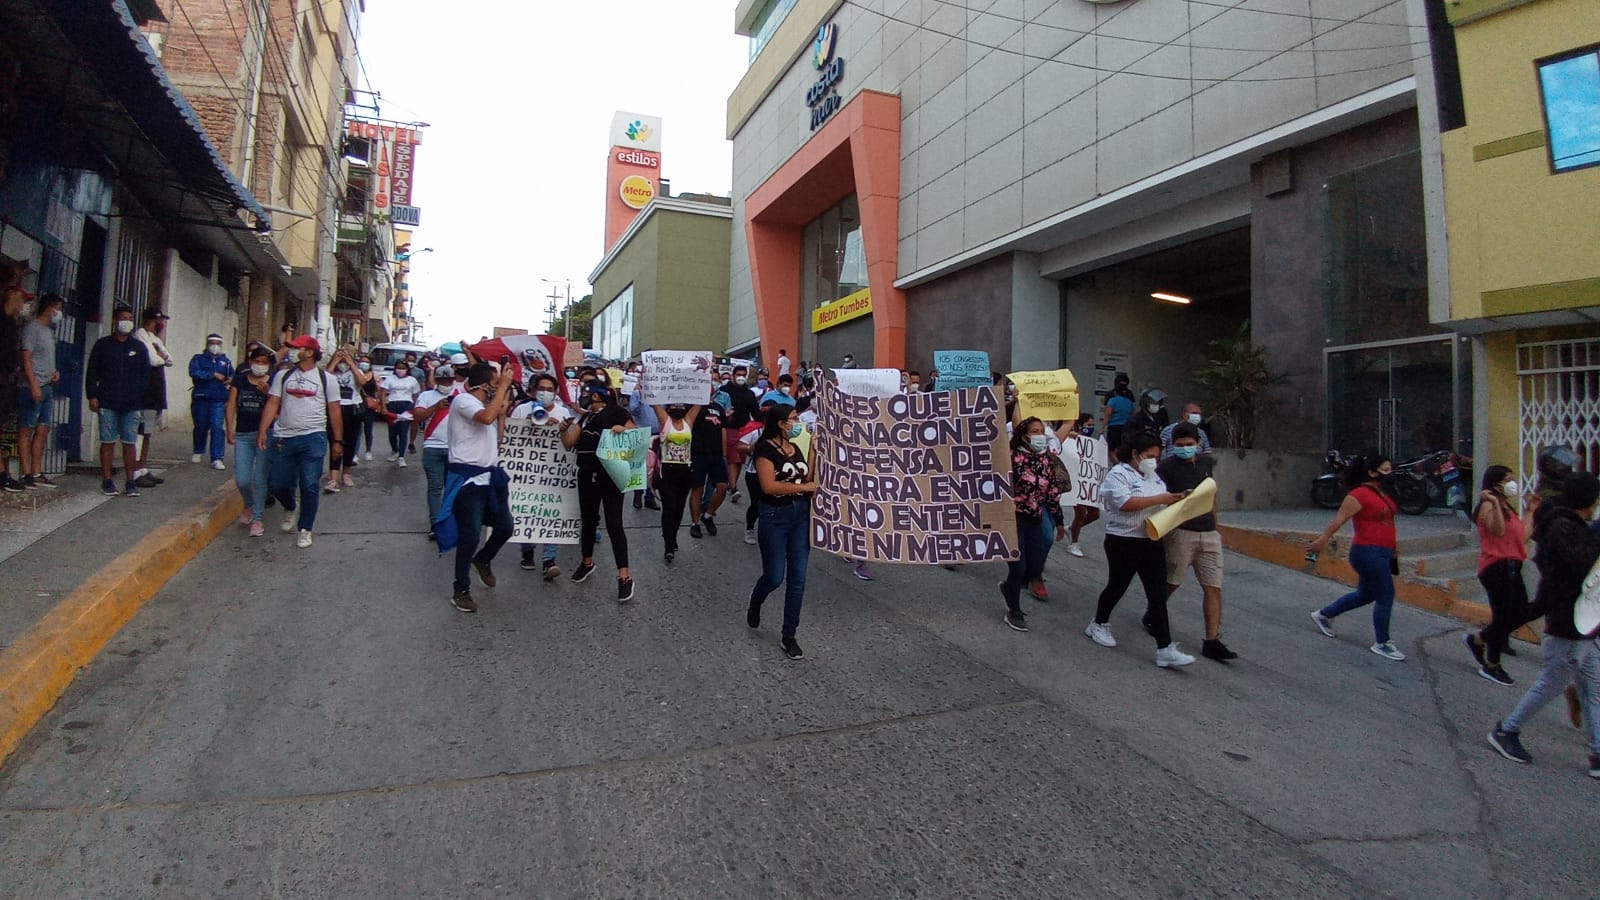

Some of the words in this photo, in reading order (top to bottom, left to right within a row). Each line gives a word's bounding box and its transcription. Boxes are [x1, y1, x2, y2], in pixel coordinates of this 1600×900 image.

[807, 57, 844, 107] costa
[349, 121, 416, 144] HOTEL
[392, 142, 411, 204] SPEDAJE
[618, 152, 657, 167] estilos
[375, 146, 390, 208] ISIS
[623, 186, 652, 197] Metro
[391, 206, 419, 222] RDOVA
[819, 308, 838, 325] Metro
[840, 297, 869, 316] Tumbes
[825, 381, 880, 421] CREES
[887, 390, 950, 423] QUE
[957, 386, 999, 416] LA
[501, 436, 560, 450] DEJARLE
[504, 424, 518, 435] NO
[968, 414, 999, 444] ES
[529, 451, 547, 461] DE
[553, 453, 567, 464] LA
[835, 440, 944, 475] DEFENSA
[951, 444, 992, 473] DE
[512, 474, 537, 485] MIS
[539, 477, 577, 489] HIJOS
[817, 453, 922, 502] VIZCARRA
[812, 487, 841, 522] CES
[847, 499, 884, 529] NO
[539, 528, 580, 539] PEDIMOS
[813, 518, 867, 558] DISTE
[872, 532, 902, 561] NI
